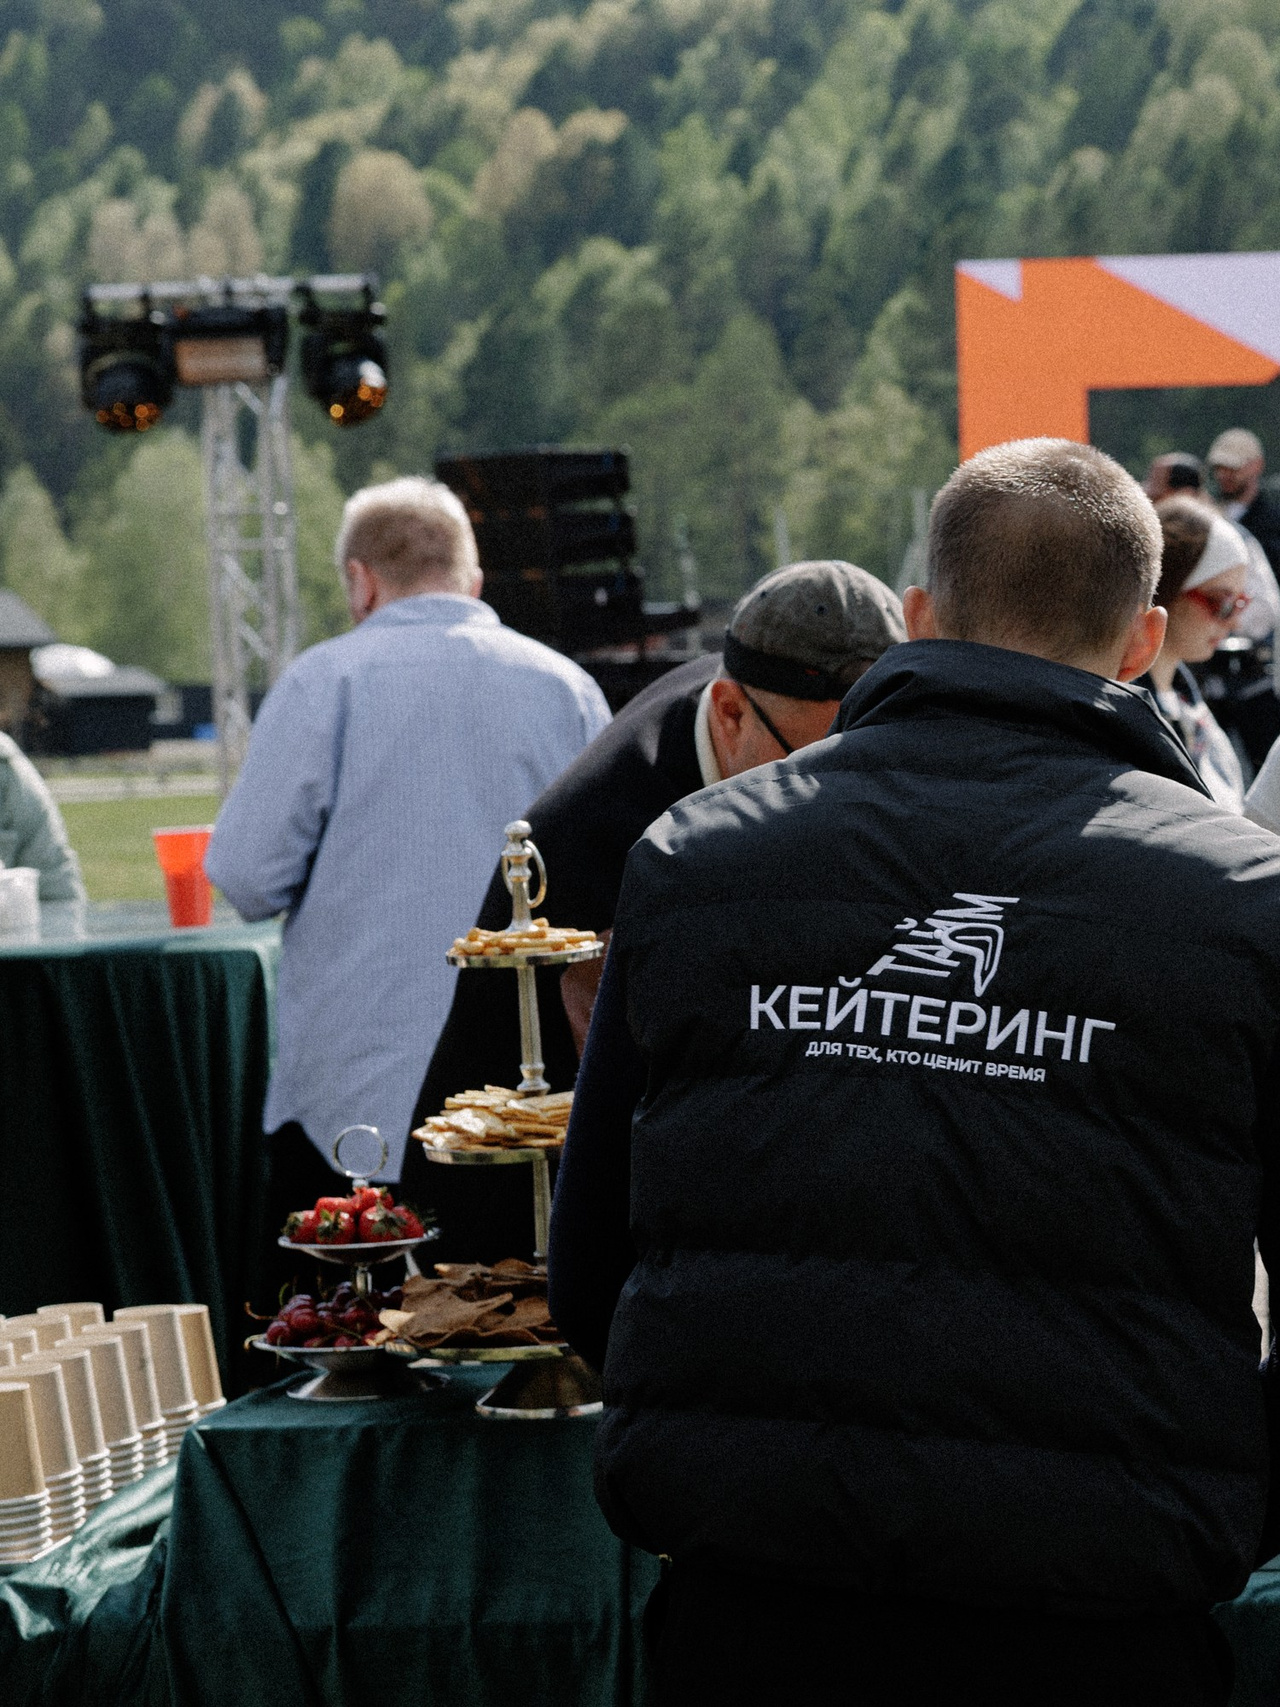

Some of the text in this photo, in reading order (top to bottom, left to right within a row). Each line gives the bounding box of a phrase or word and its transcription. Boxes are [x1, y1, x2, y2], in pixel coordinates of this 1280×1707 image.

[749, 975, 1117, 1063] КЕЙТЕРИНГ
[805, 1041, 1046, 1082] ДЛЯ ТЕХ, КТО ЦЕНИТ ВРЕМЯ
